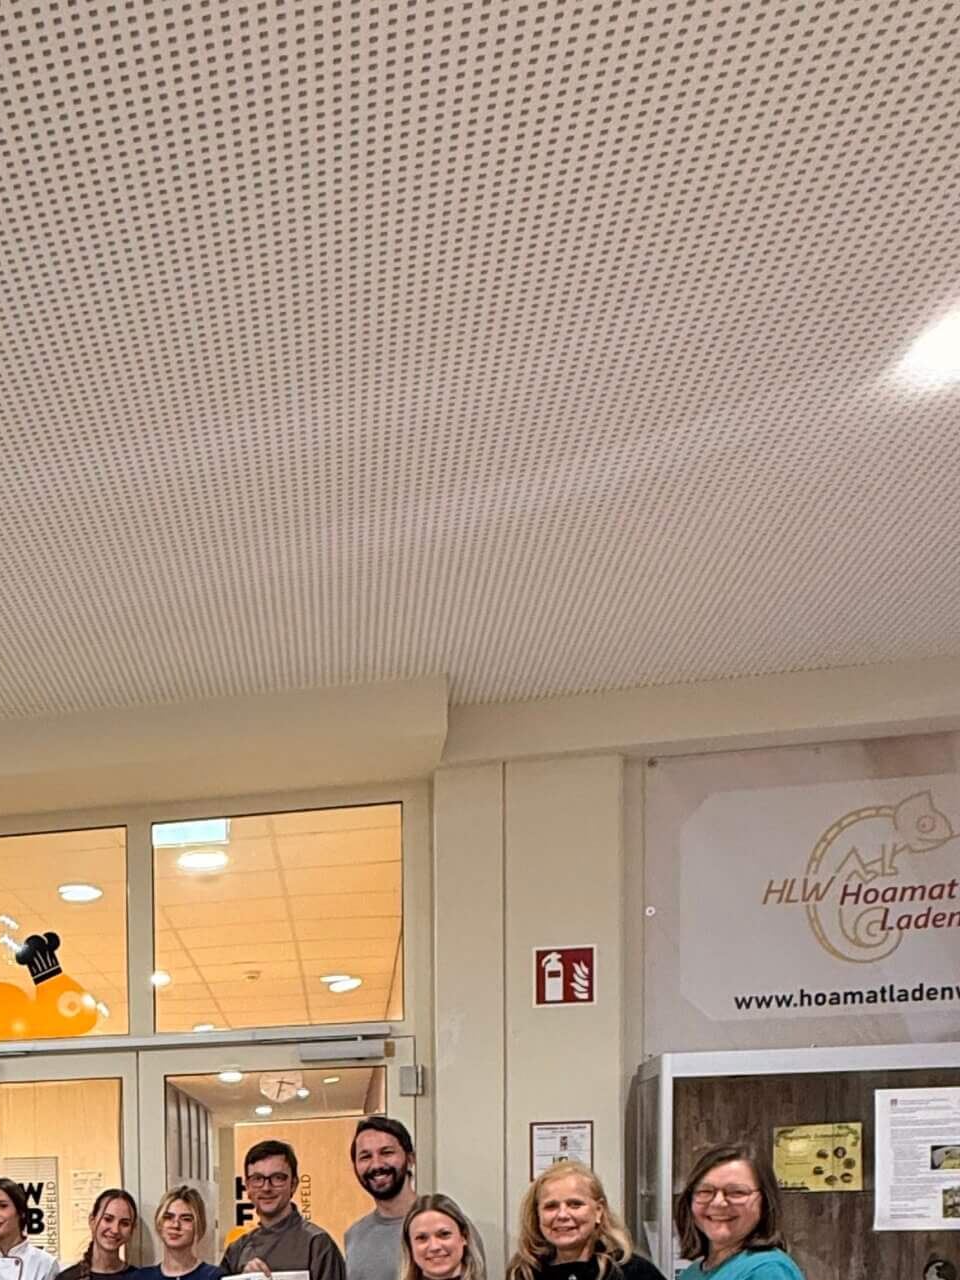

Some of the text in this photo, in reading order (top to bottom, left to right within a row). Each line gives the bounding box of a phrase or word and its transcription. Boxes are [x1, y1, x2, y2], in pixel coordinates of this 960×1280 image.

[762, 876, 959, 906] HLW Hoamat
[879, 906, 960, 931] Laden
[300, 1174, 312, 1220] ENFELD
